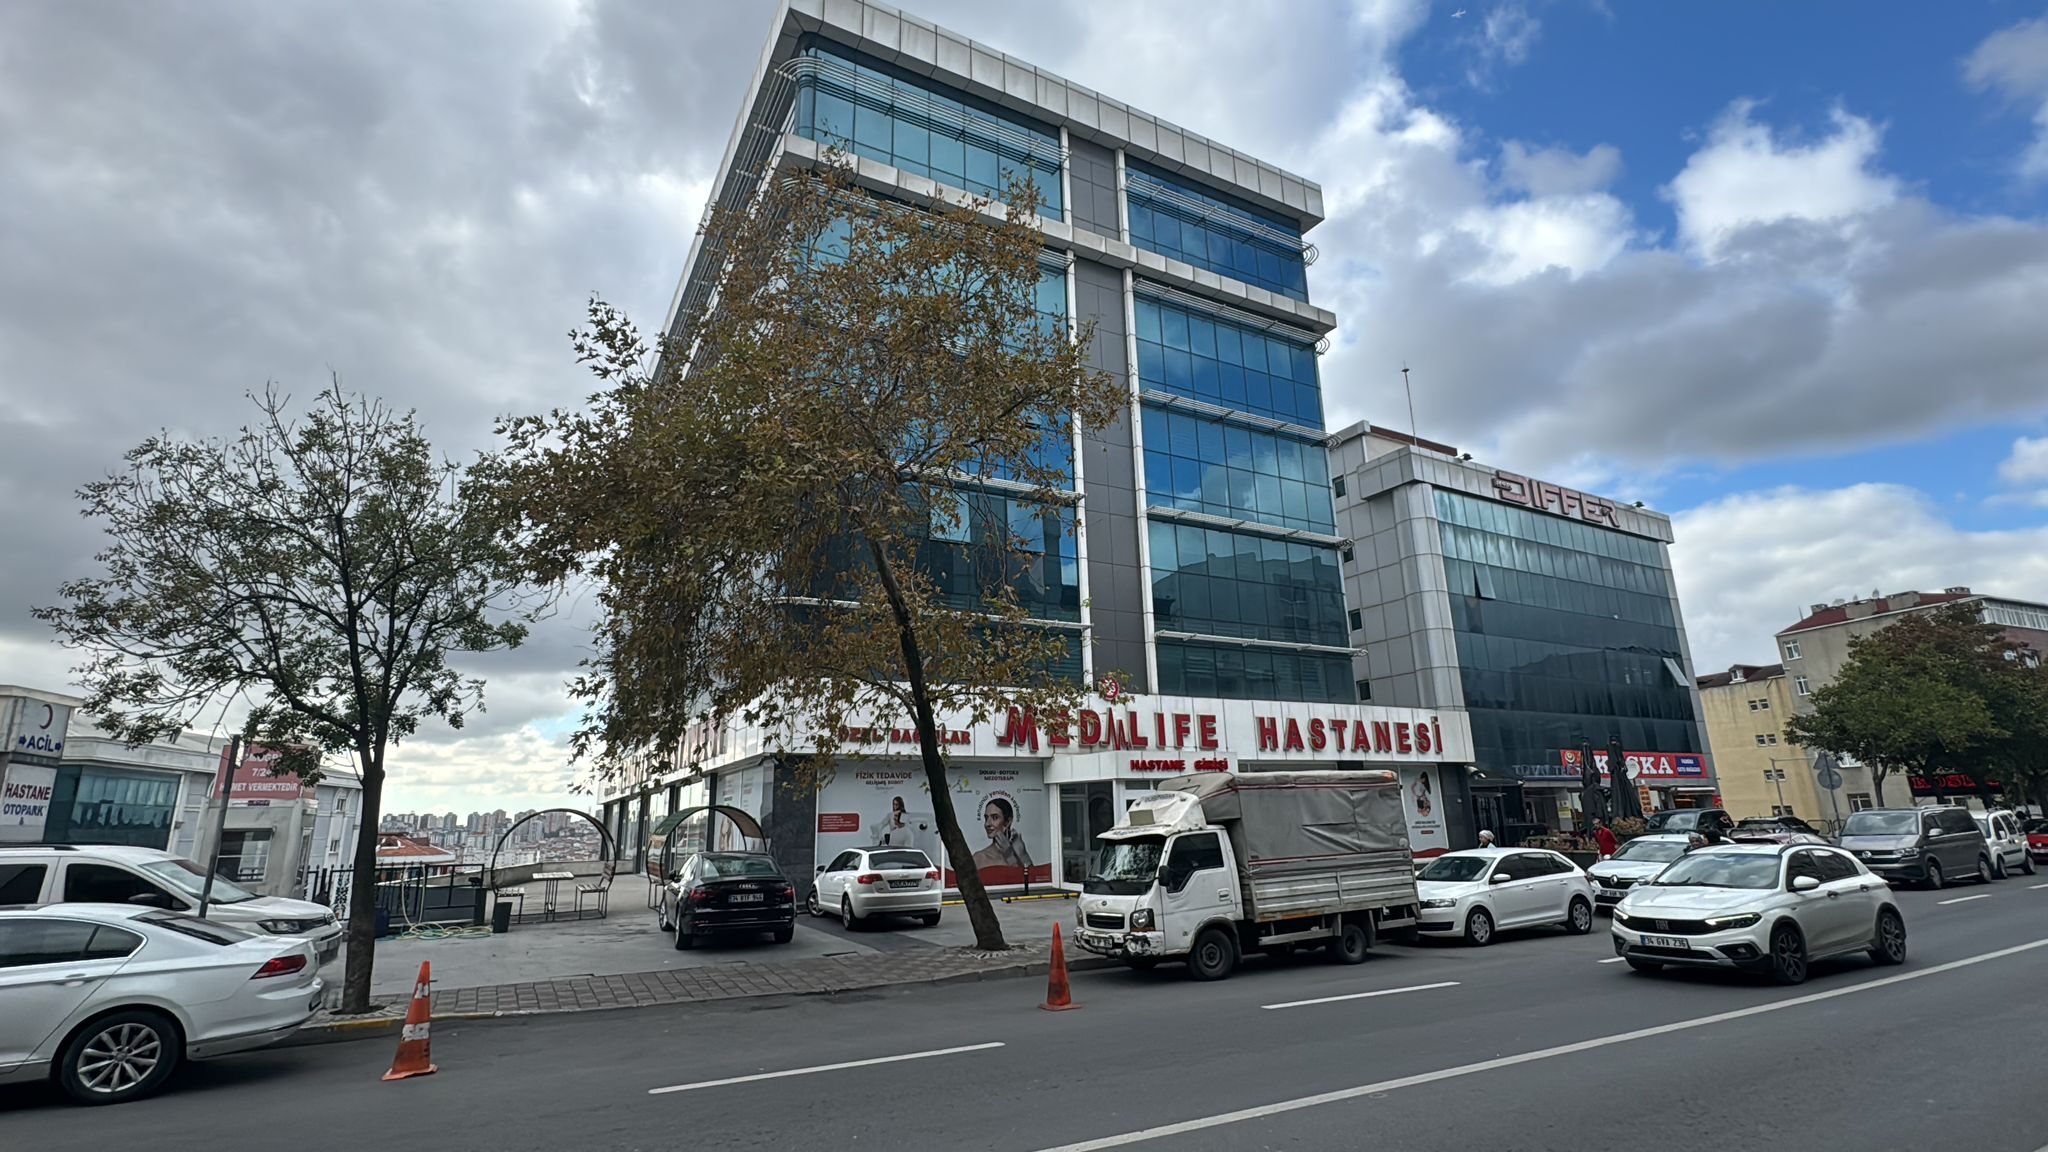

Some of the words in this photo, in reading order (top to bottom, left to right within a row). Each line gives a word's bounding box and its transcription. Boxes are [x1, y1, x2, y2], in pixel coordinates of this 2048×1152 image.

[1495, 470, 1620, 528] DIFFER
[1256, 716, 1444, 754] HASTANESİ
[26, 734, 55, 753] ACİL
[1130, 759, 1186, 772] HASTANE
[1193, 757, 1229, 773] GİRİŞİ
[855, 771, 874, 779] FİZİK
[876, 771, 912, 779] TEDAVİDE
[5, 783, 51, 800] HASTANE
[248, 782, 298, 792] VERMEKTEDİR
[3, 803, 43, 817] OTOPARK
[1656, 937, 1670, 946] GVA
[1673, 938, 1686, 948] 236
